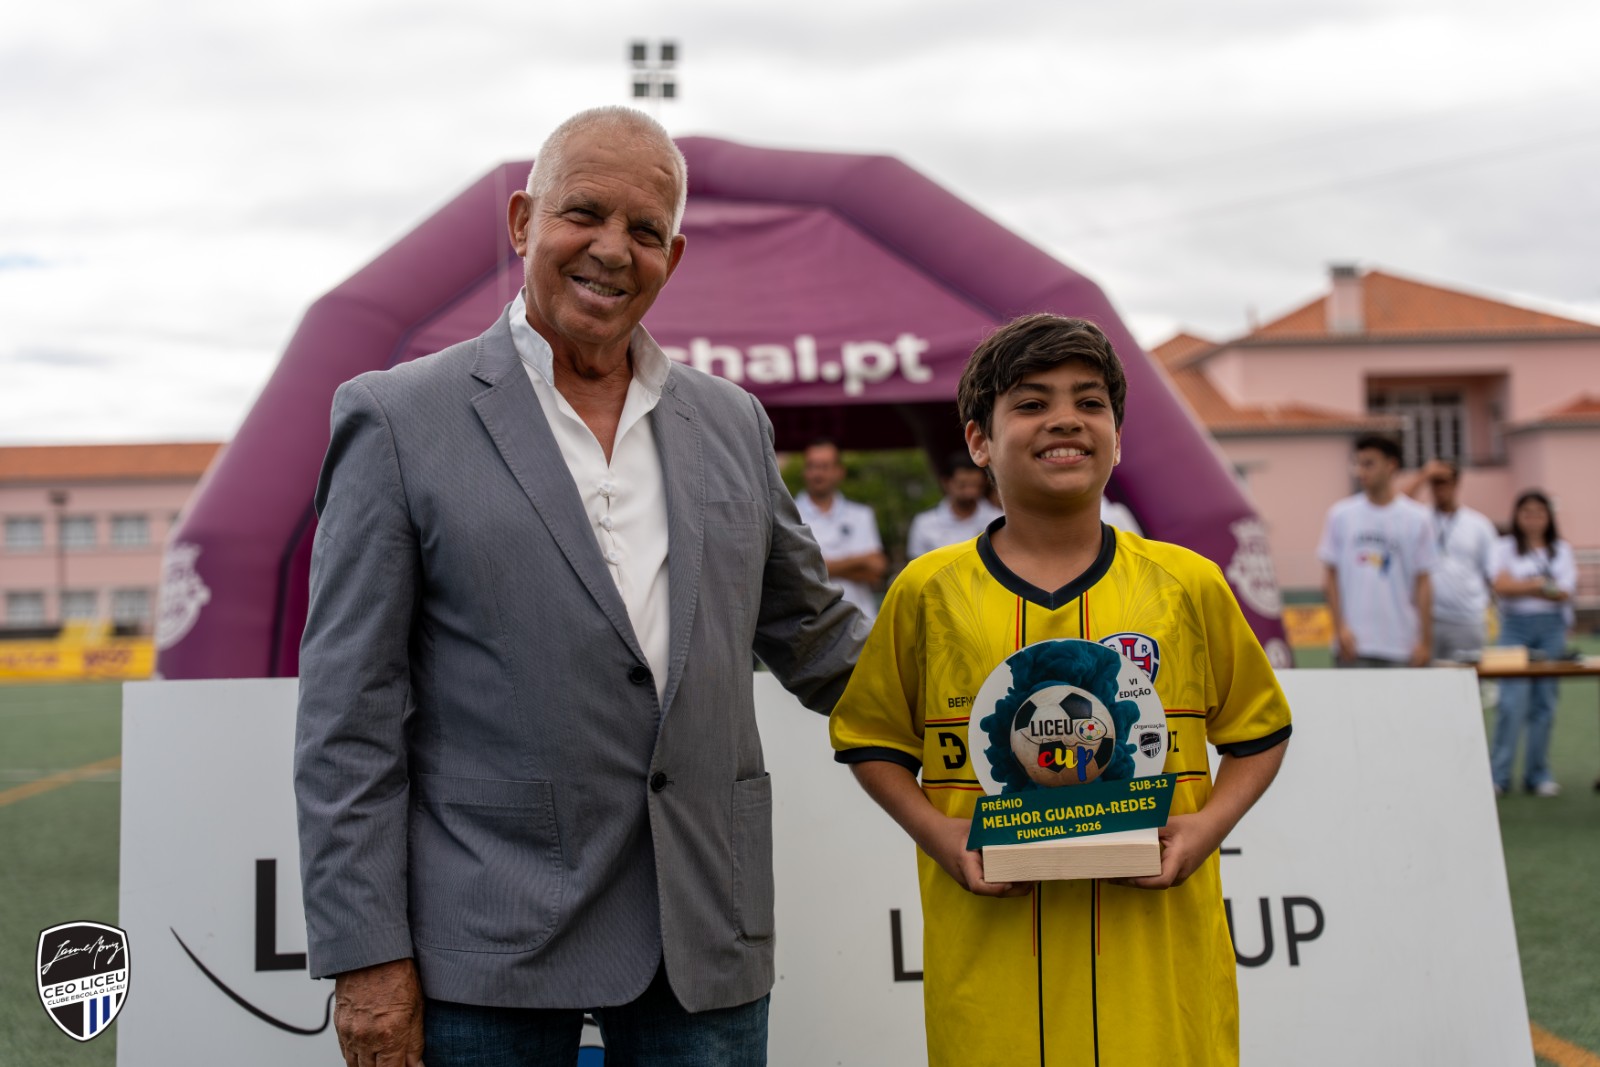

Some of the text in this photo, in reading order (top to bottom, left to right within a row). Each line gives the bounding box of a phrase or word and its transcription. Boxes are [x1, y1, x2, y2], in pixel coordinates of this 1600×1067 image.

[1128, 678, 1138, 686] VI
[1119, 687, 1152, 699] EDIÇÃO
[1030, 719, 1074, 737] LICEU
[1037, 745, 1094, 782] cup
[1129, 778, 1168, 792] SUB-12
[981, 798, 1023, 812] PRÉMIO
[982, 797, 1157, 830] MELHOR GUARDA-REDES
[1016, 825, 1067, 841] FUNCHAL
[1075, 821, 1102, 834] 2026
[1223, 896, 1325, 968] UP
